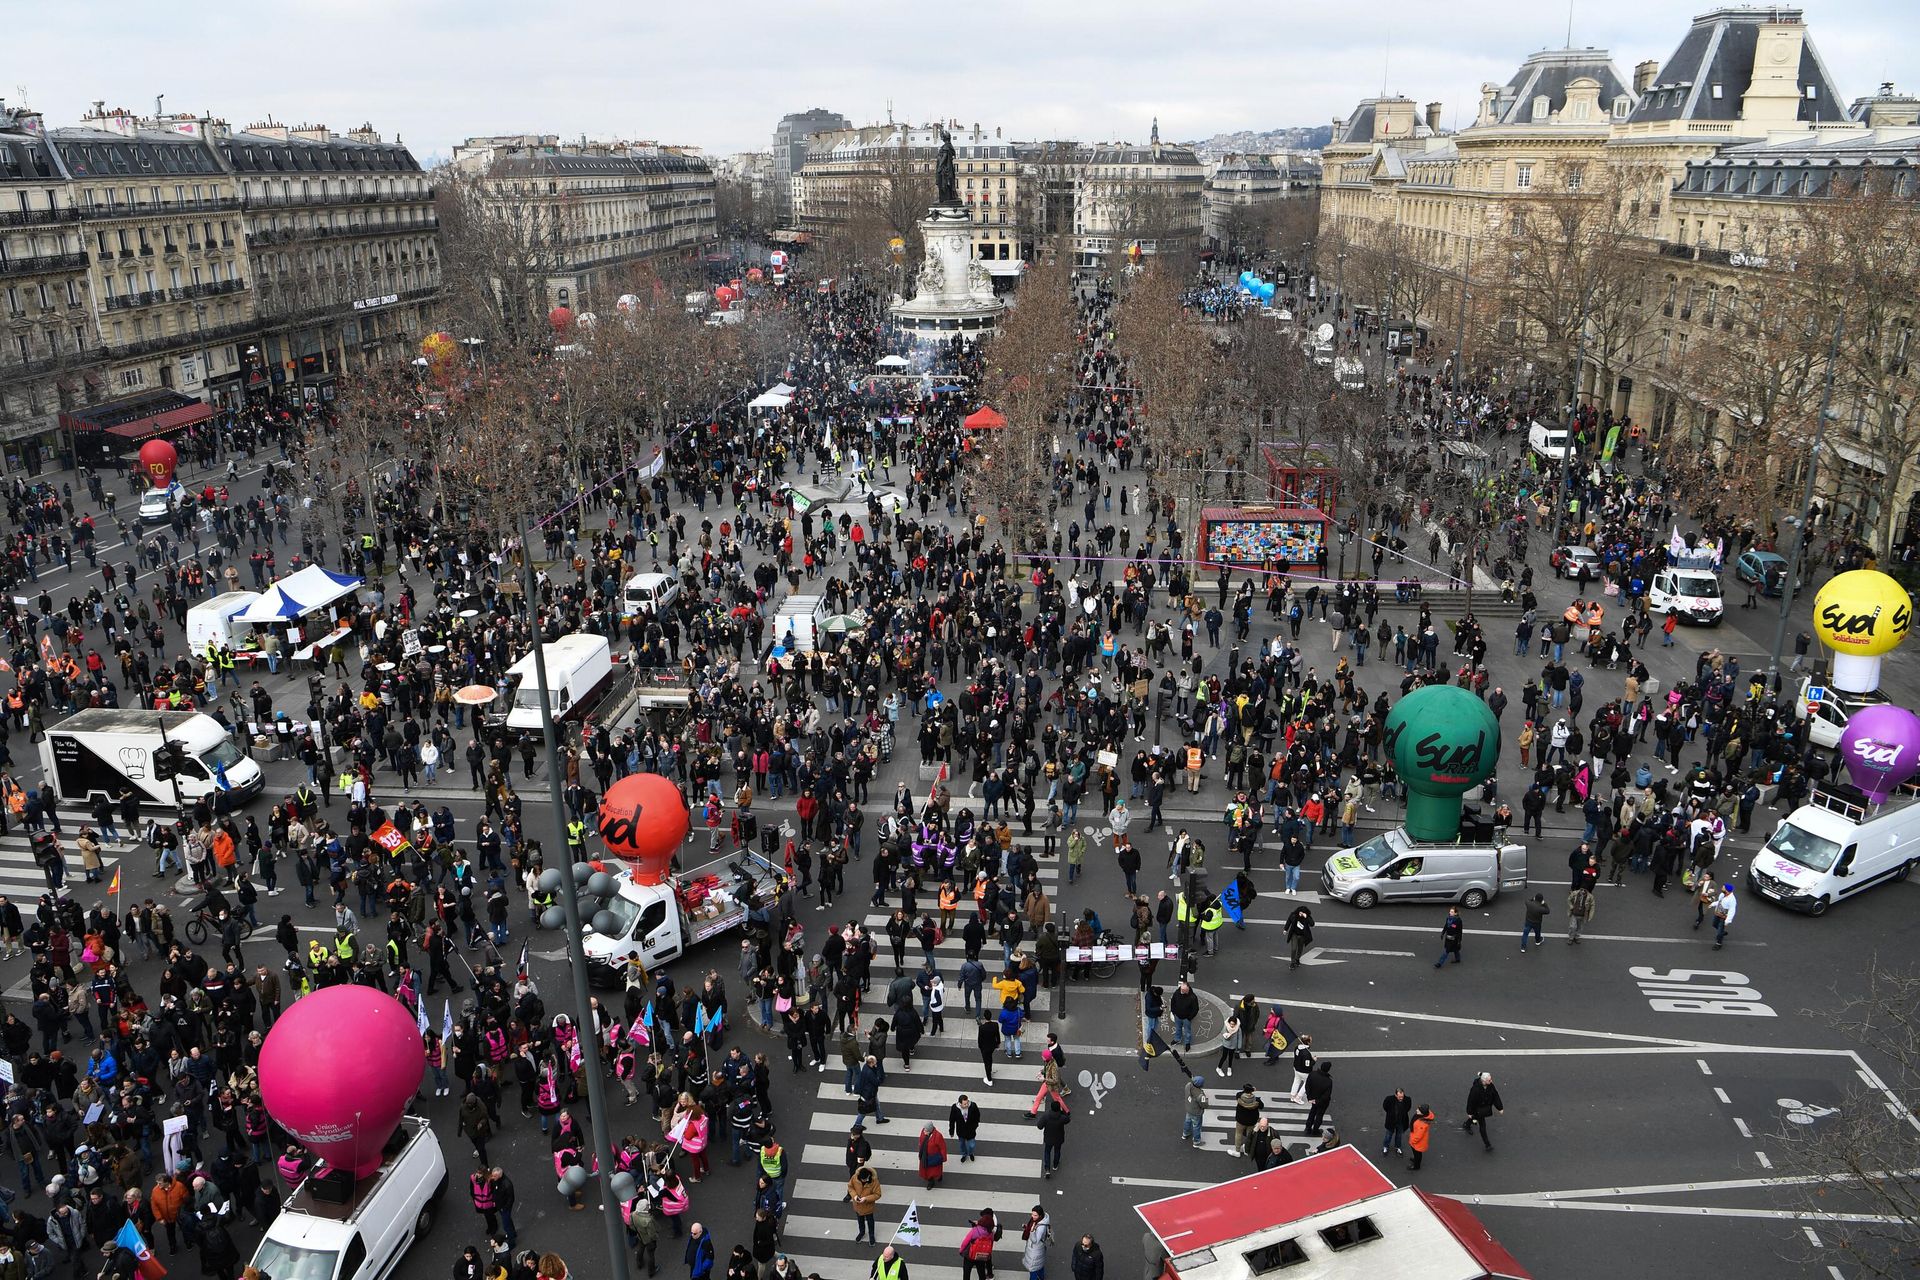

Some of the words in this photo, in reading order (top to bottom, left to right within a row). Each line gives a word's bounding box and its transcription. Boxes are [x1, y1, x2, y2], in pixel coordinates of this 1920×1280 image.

[1822, 604, 1881, 636] Sud
[1833, 633, 1870, 645] Solidaires
[1416, 730, 1485, 771] Sud
[1853, 738, 1904, 766] Sud
[599, 804, 643, 849] ud
[1628, 966, 1778, 1017] BUS
